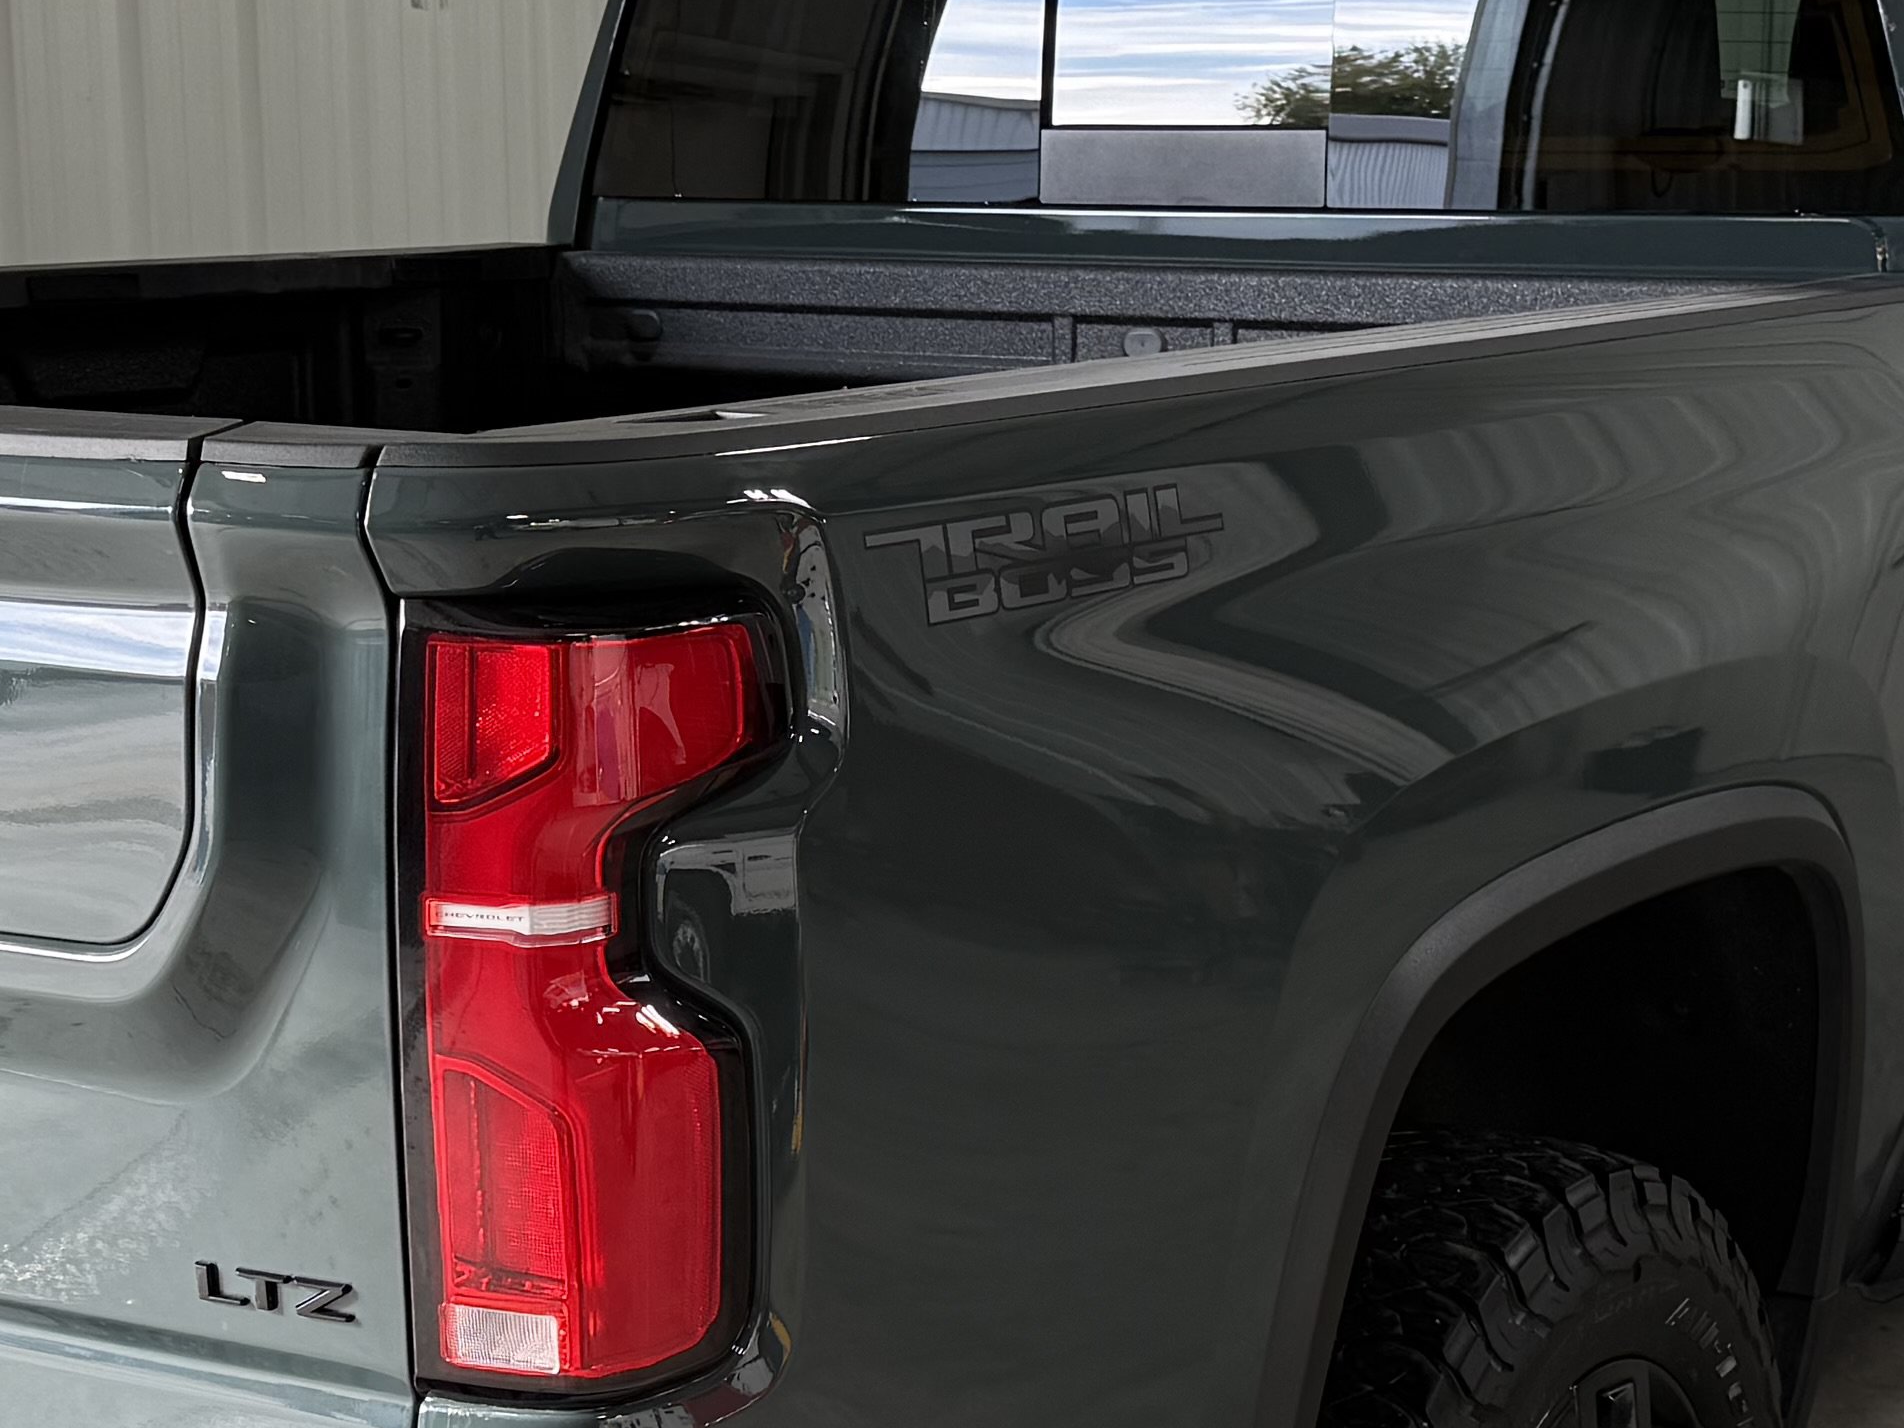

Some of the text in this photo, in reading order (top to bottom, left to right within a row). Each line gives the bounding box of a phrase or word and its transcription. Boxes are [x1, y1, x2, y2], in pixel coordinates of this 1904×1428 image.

[864, 483, 1224, 578] TRAIL
[925, 536, 1189, 626] BOSS
[436, 911, 525, 923] CHEVROLET
[194, 1260, 357, 1323] LTZ
